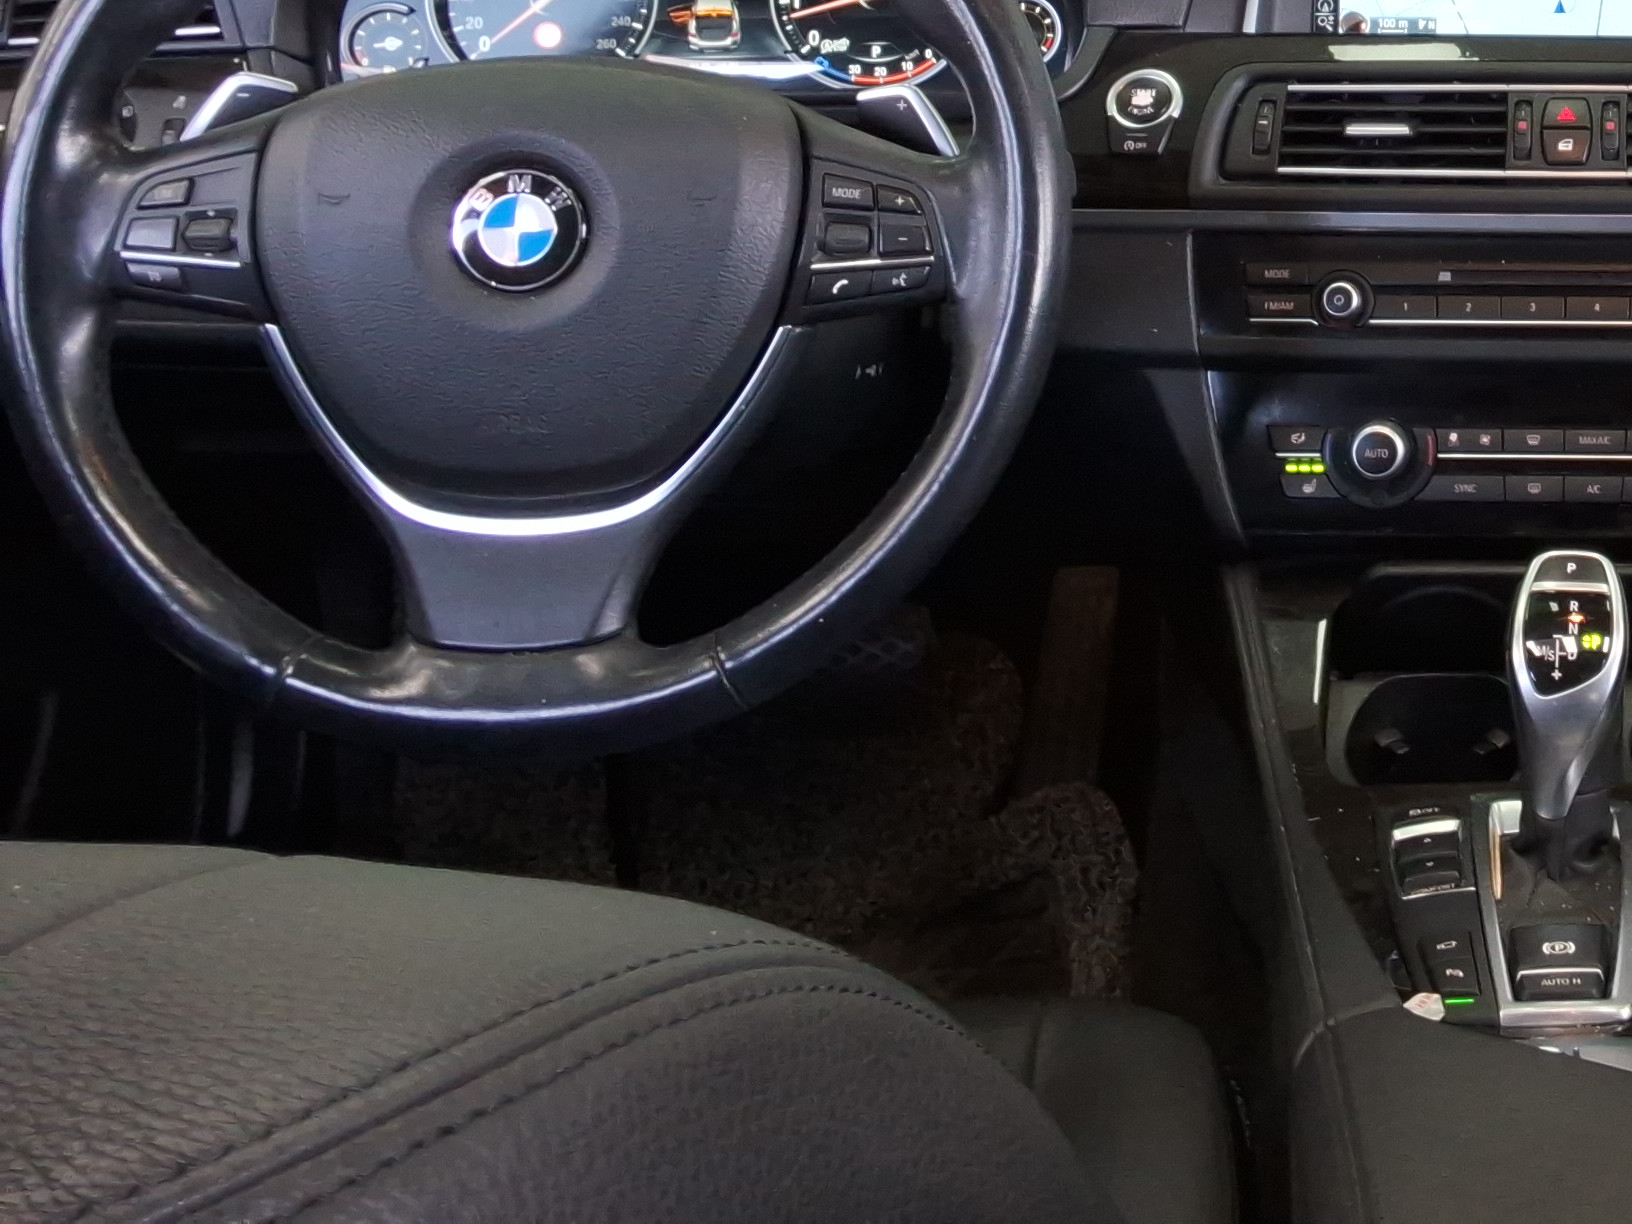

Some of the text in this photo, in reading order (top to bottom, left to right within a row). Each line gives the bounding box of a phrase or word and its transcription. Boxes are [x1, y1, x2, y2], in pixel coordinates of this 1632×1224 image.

[464, 16, 485, 30] 20
[1377, 18, 1396, 28] 100
[478, 35, 491, 52] 0
[808, 30, 820, 45] 0
[871, 45, 882, 58] P
[874, 66, 888, 77] 20
[901, 61, 914, 72] 10
[468, 174, 572, 212] BMW
[831, 187, 862, 199] MODE
[1264, 269, 1291, 279] MODE
[1364, 448, 1389, 459] AUTO
[1453, 484, 1478, 494] SYNC
[1586, 484, 1601, 494] A/C
[1566, 562, 1577, 574] P
[1569, 600, 1579, 612] R
[1568, 623, 1579, 635] N
[1541, 977, 1570, 986] AUTO
